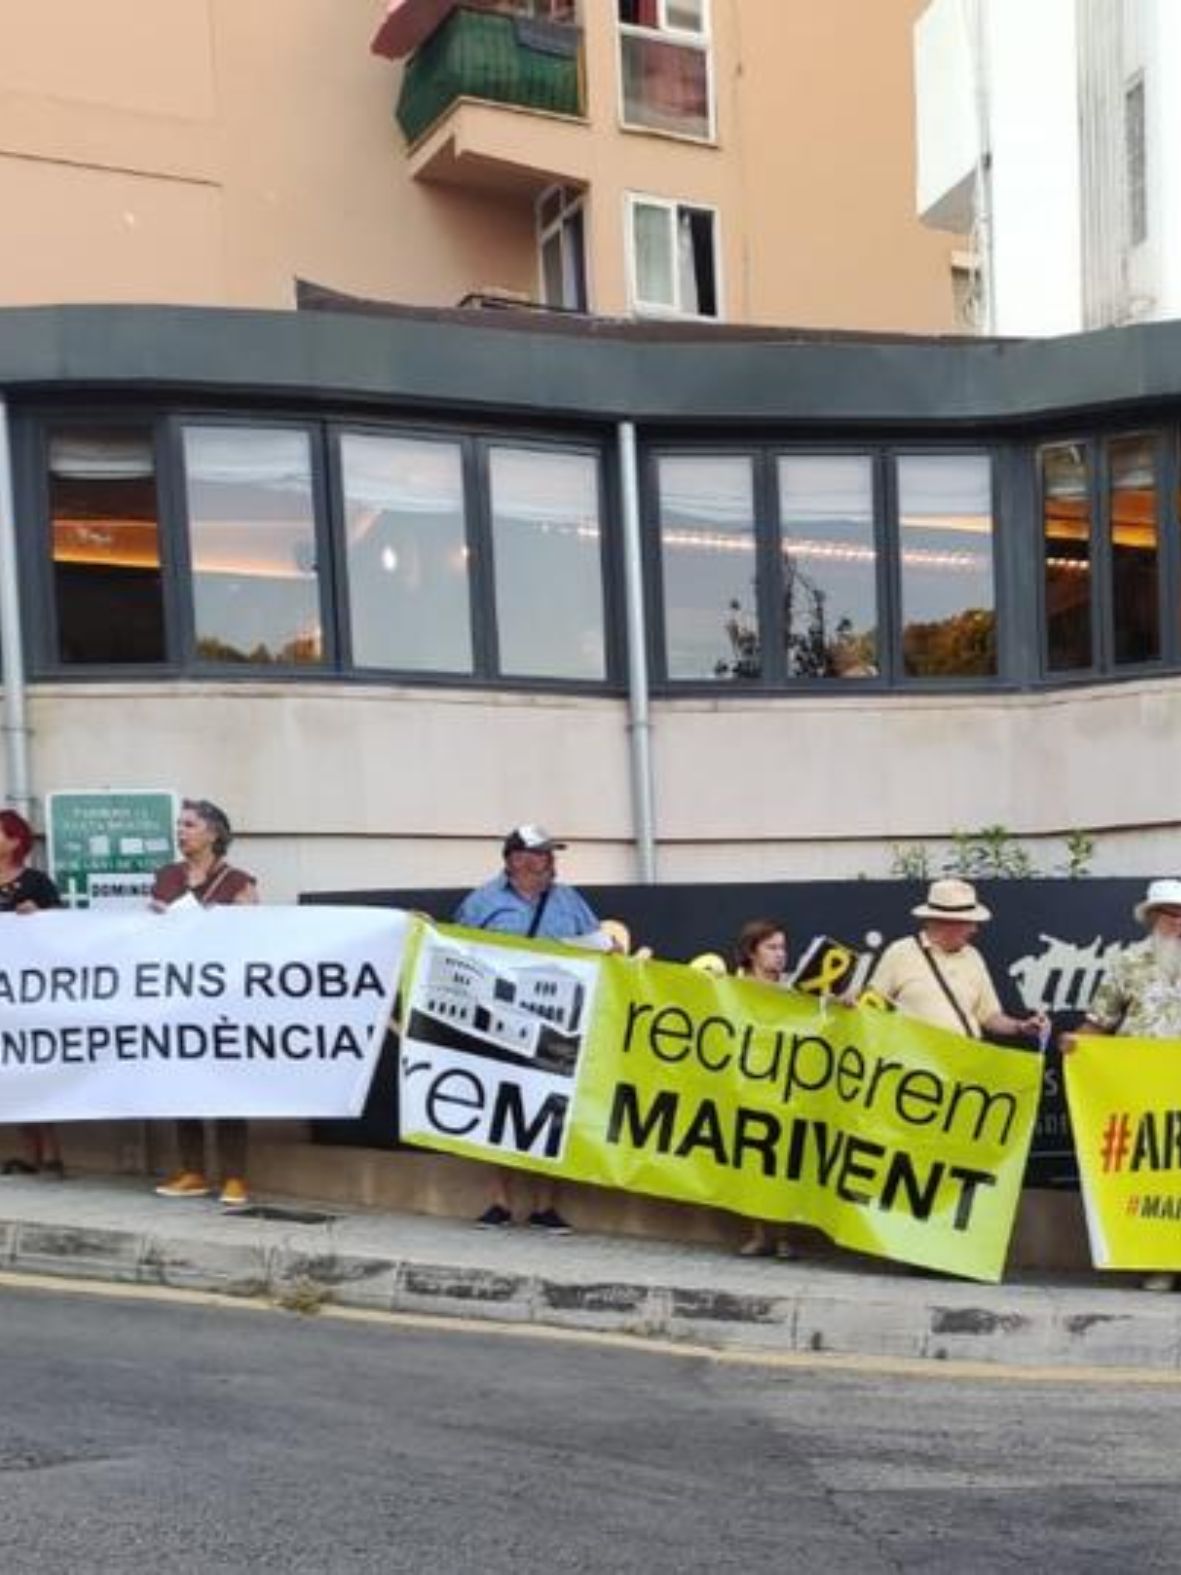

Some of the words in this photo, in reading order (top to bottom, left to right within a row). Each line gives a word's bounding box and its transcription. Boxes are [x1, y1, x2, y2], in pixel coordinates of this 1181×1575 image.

[0, 965, 119, 1003] ADRID
[135, 962, 226, 998] ENS
[244, 963, 386, 998] ROBA
[1, 1016, 375, 1065] NDEPENDÈNCIA
[622, 1000, 1019, 1146] recuperem
[605, 1082, 997, 1232] MARIVENT
